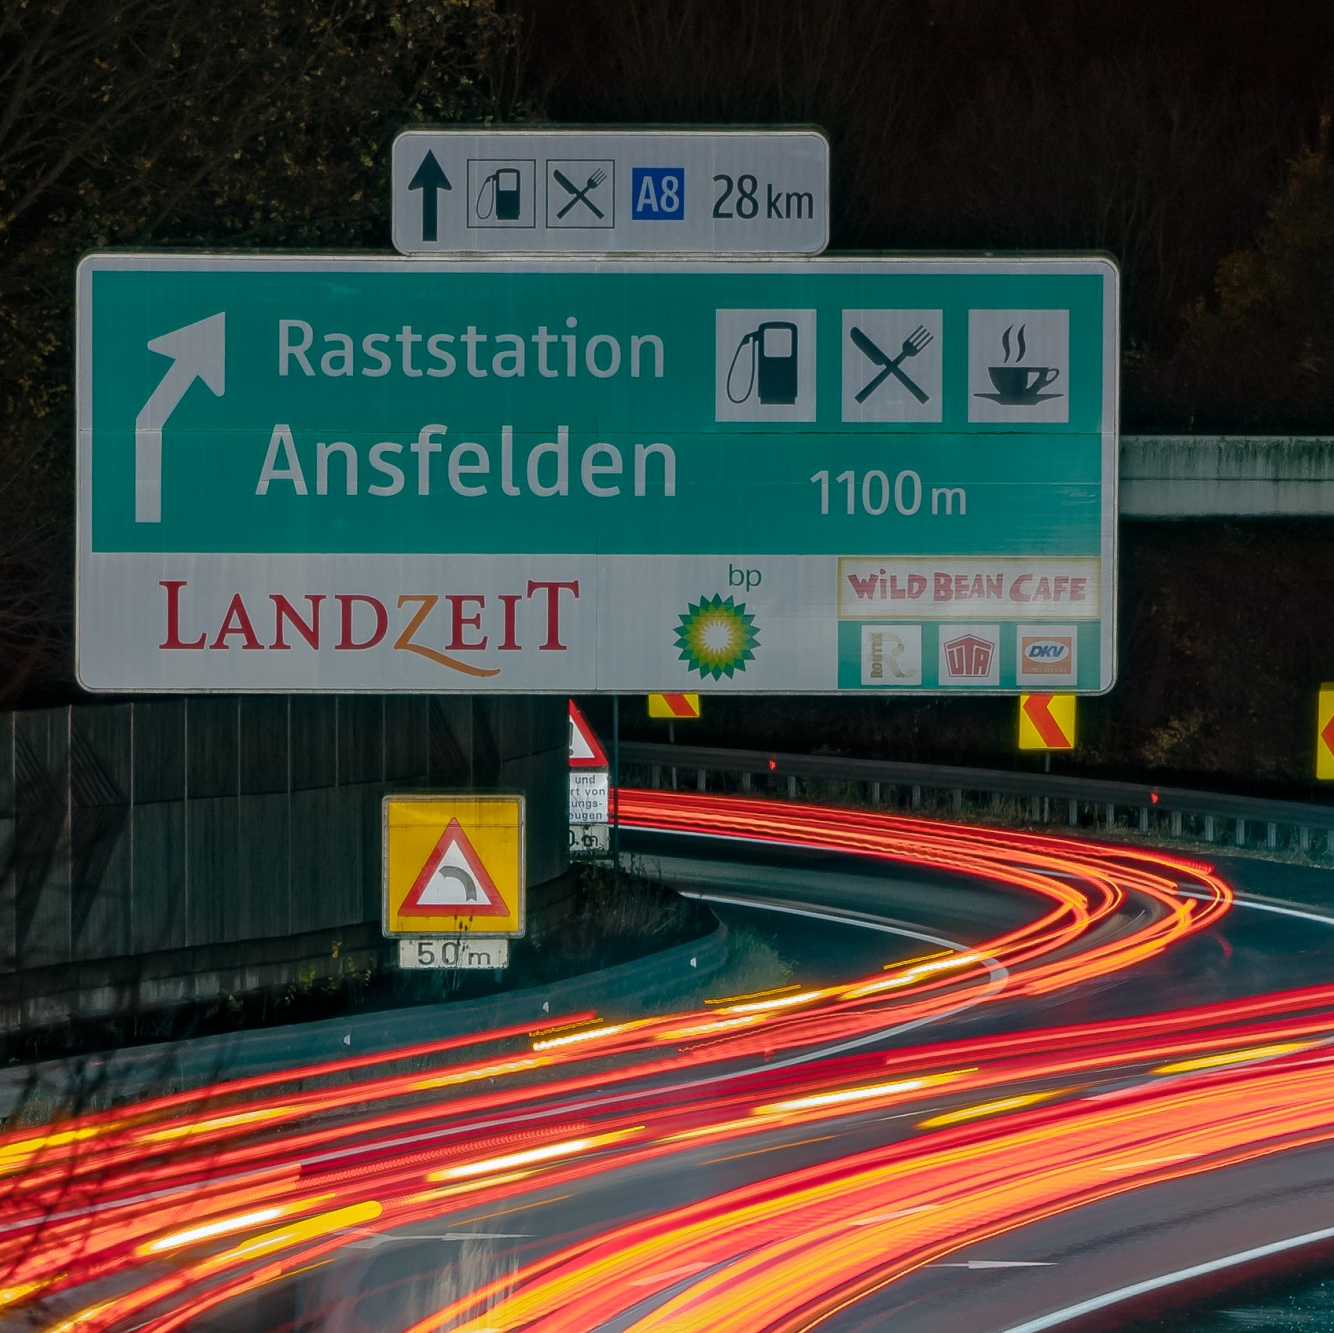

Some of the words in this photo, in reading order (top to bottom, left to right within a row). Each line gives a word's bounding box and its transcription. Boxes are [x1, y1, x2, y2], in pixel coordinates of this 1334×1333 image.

[636, 175, 680, 214] A8
[712, 173, 759, 219] 28
[765, 179, 814, 219] km
[279, 315, 665, 378] Raststation
[256, 423, 678, 497] Ansfelden
[810, 469, 923, 516] 1100
[931, 483, 967, 516] m
[728, 565, 762, 591] bp
[933, 572, 1004, 601] BEAN
[1009, 573, 1087, 603] CAFE
[159, 579, 581, 677] LANDZEIT
[946, 635, 993, 675] UTA
[1028, 645, 1065, 658] DKV
[574, 774, 595, 785] und
[584, 788, 606, 796] von
[417, 942, 458, 966] 50
[468, 950, 491, 966] m
